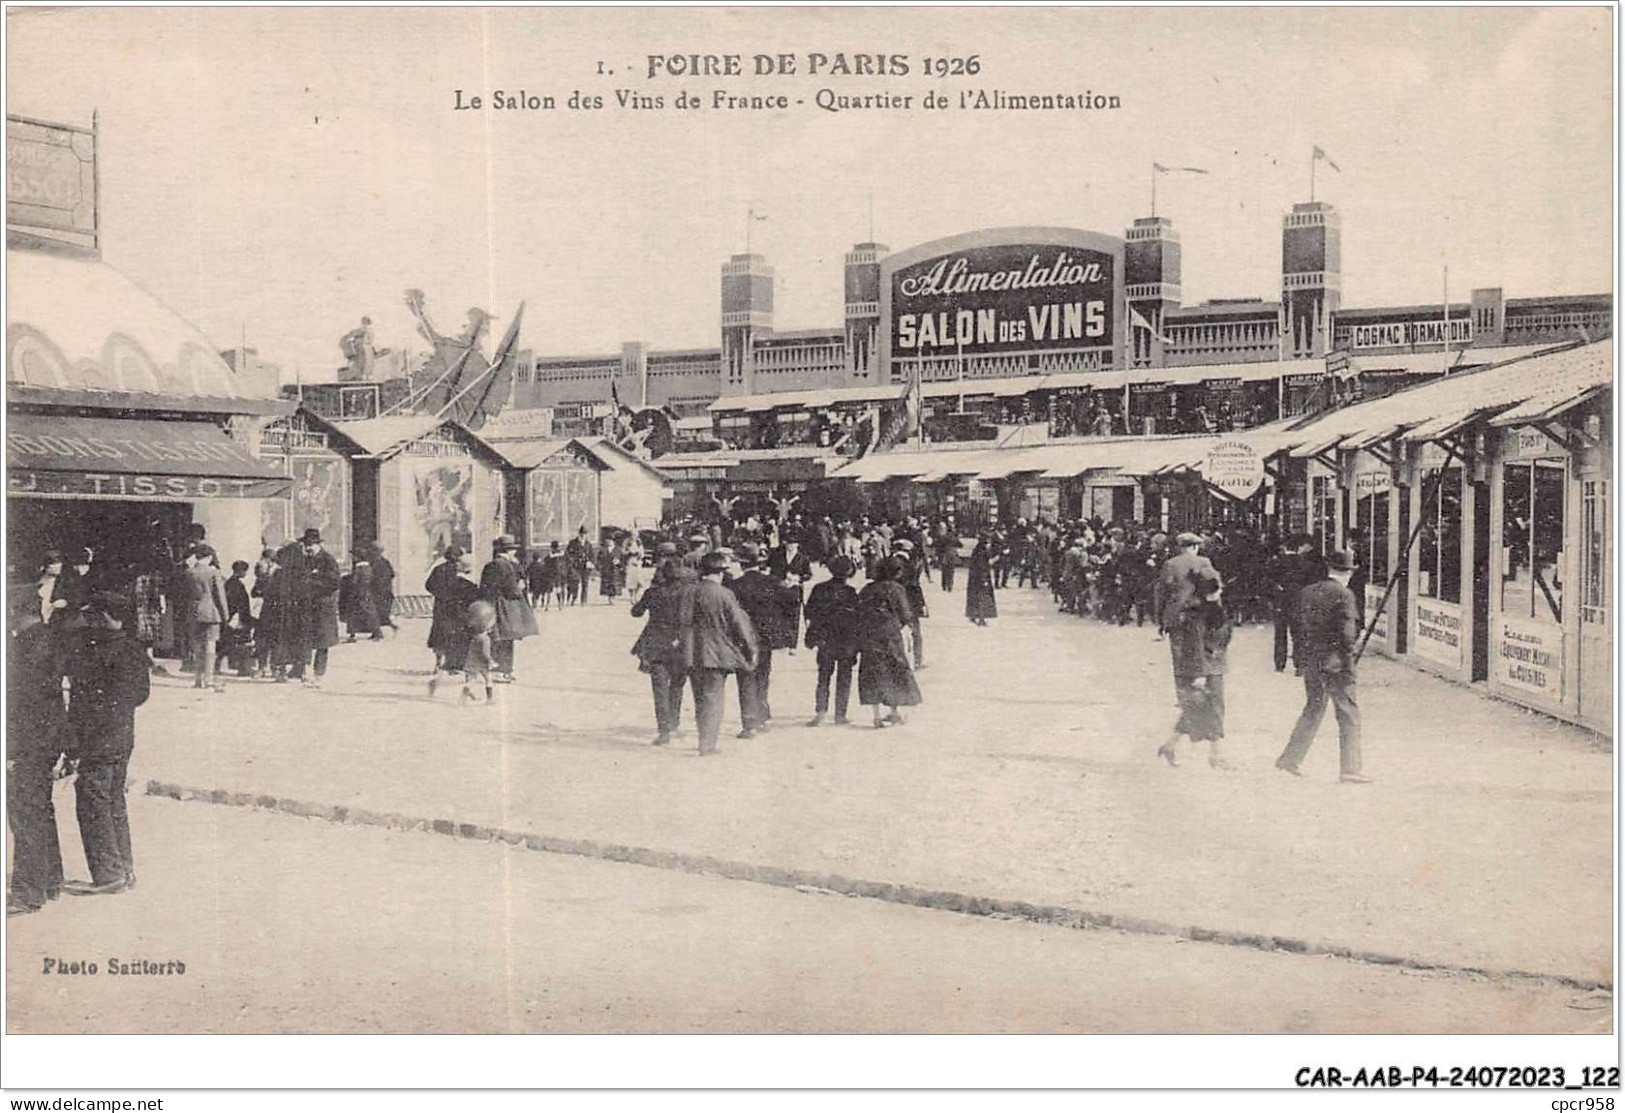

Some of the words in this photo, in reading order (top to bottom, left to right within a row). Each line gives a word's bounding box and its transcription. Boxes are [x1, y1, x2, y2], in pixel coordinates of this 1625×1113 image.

[900, 253, 1104, 297] Alimentation
[898, 308, 995, 348] SALON
[1002, 319, 1027, 343] DES
[1028, 300, 1106, 342] VINS
[1356, 325, 1399, 346] COGNAC
[85, 473, 256, 497] TISSOT
